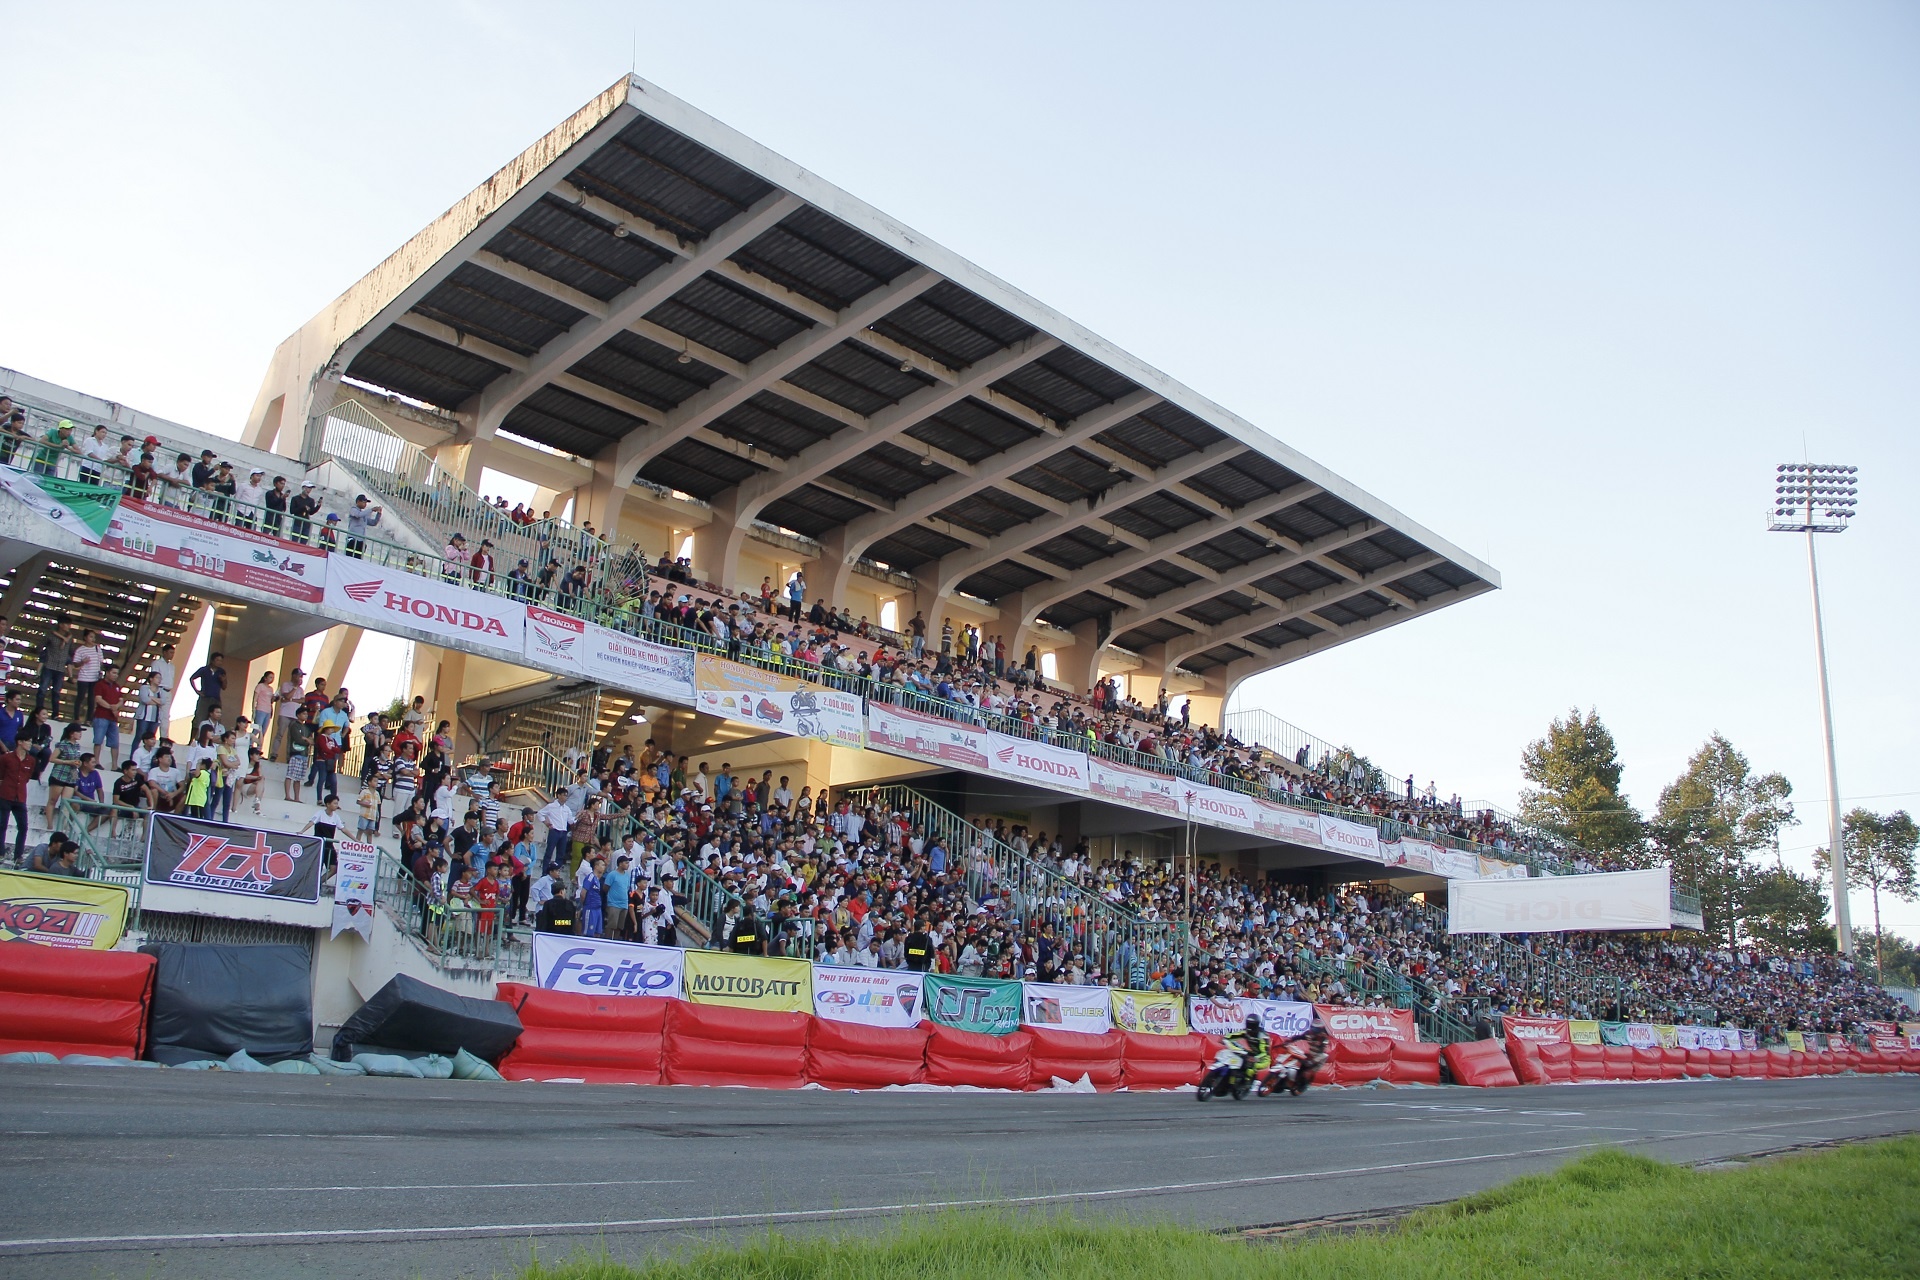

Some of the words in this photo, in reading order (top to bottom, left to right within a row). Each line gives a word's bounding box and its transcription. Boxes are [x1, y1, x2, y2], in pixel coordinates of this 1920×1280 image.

[384, 591, 508, 638] HONDA
[542, 615, 578, 630] HONDA
[720, 661, 746, 674] HONDA
[1016, 753, 1081, 780] HONDA
[1200, 798, 1248, 820] HONDA
[341, 841, 374, 854] CHOHO
[1336, 830, 1376, 849] HONDA
[209, 877, 230, 888] XE
[0, 904, 81, 936] KOZI
[28, 934, 93, 946] PERFORMANCE
[545, 948, 674, 990] Faito
[693, 974, 800, 997] MOTOBATT
[819, 974, 836, 983] PHỤ
[838, 974, 860, 983] TÙNG
[872, 977, 890, 985] MÁY
[1062, 1006, 1104, 1017] TILIER
[1263, 1007, 1309, 1031] Faito
